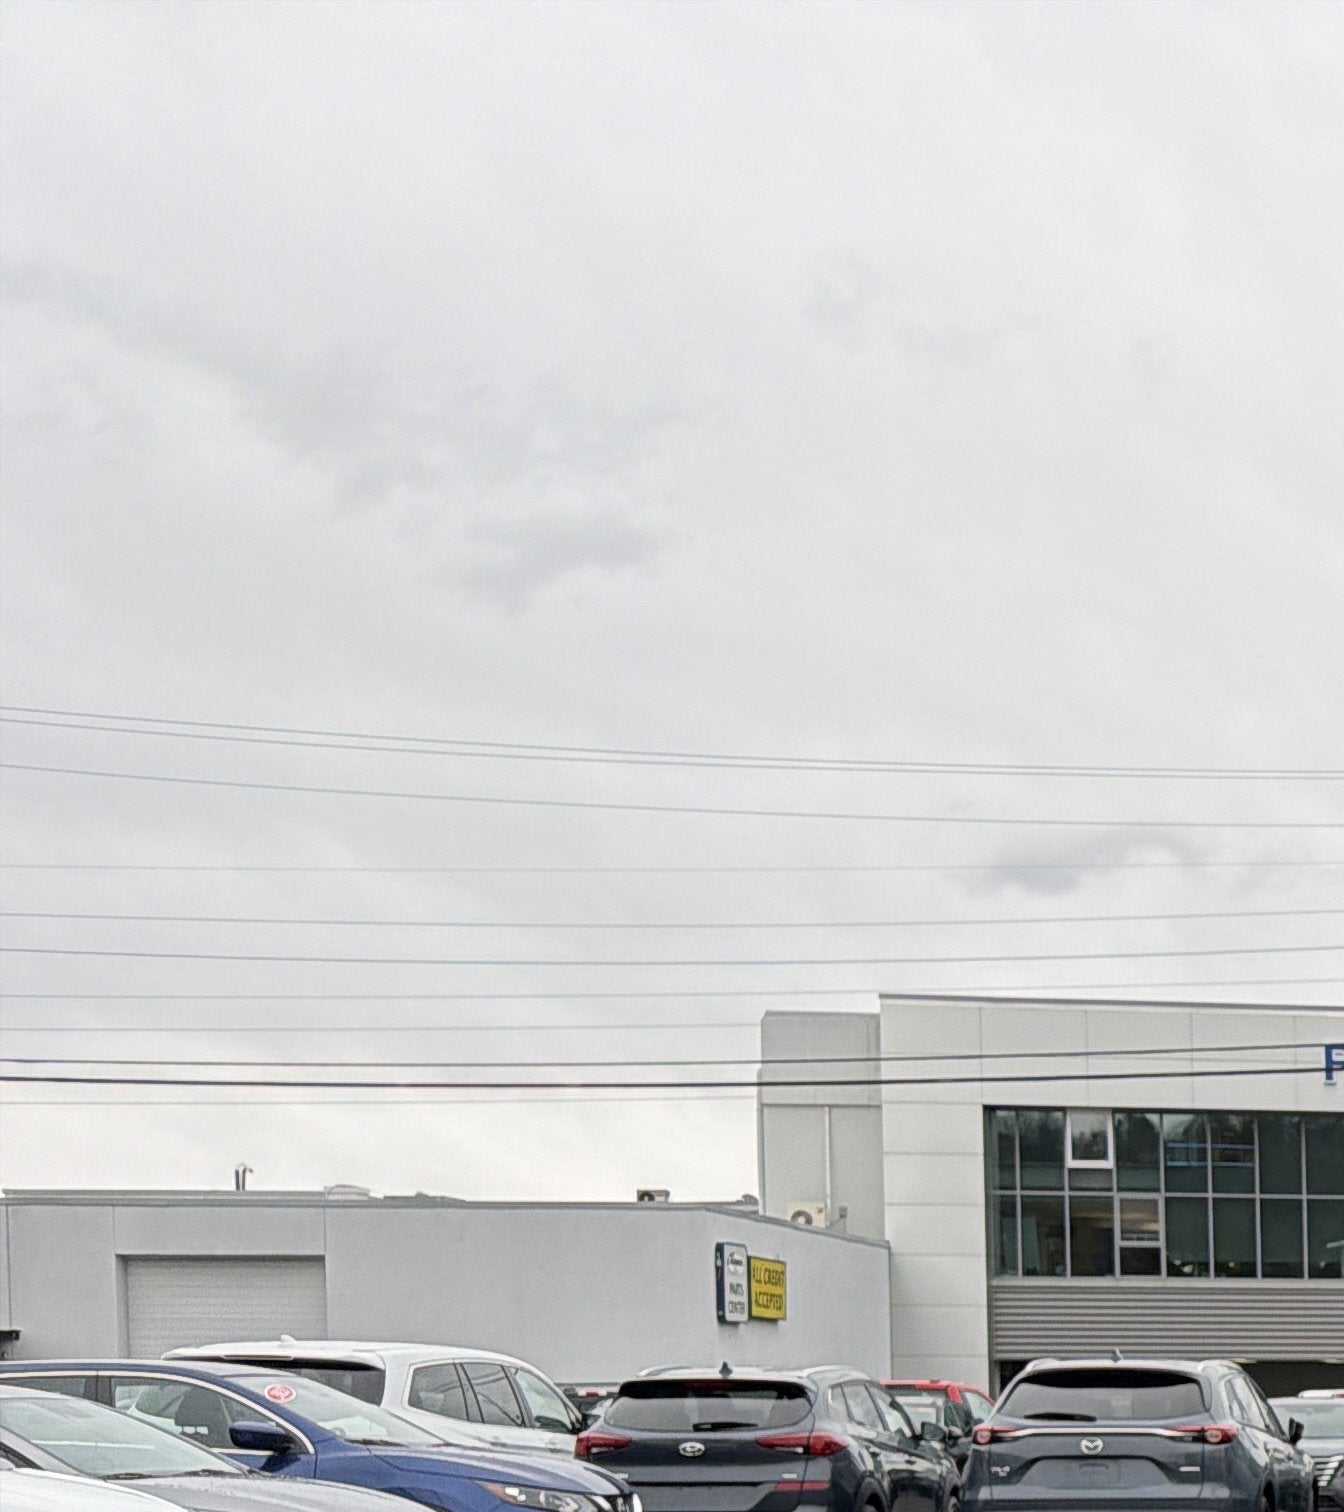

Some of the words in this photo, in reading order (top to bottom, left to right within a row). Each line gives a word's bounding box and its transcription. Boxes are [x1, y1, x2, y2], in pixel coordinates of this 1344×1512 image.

[752, 1263, 763, 1284] ALL
[763, 1266, 785, 1289] CREDIT
[754, 1289, 784, 1311] ACCEPTED
